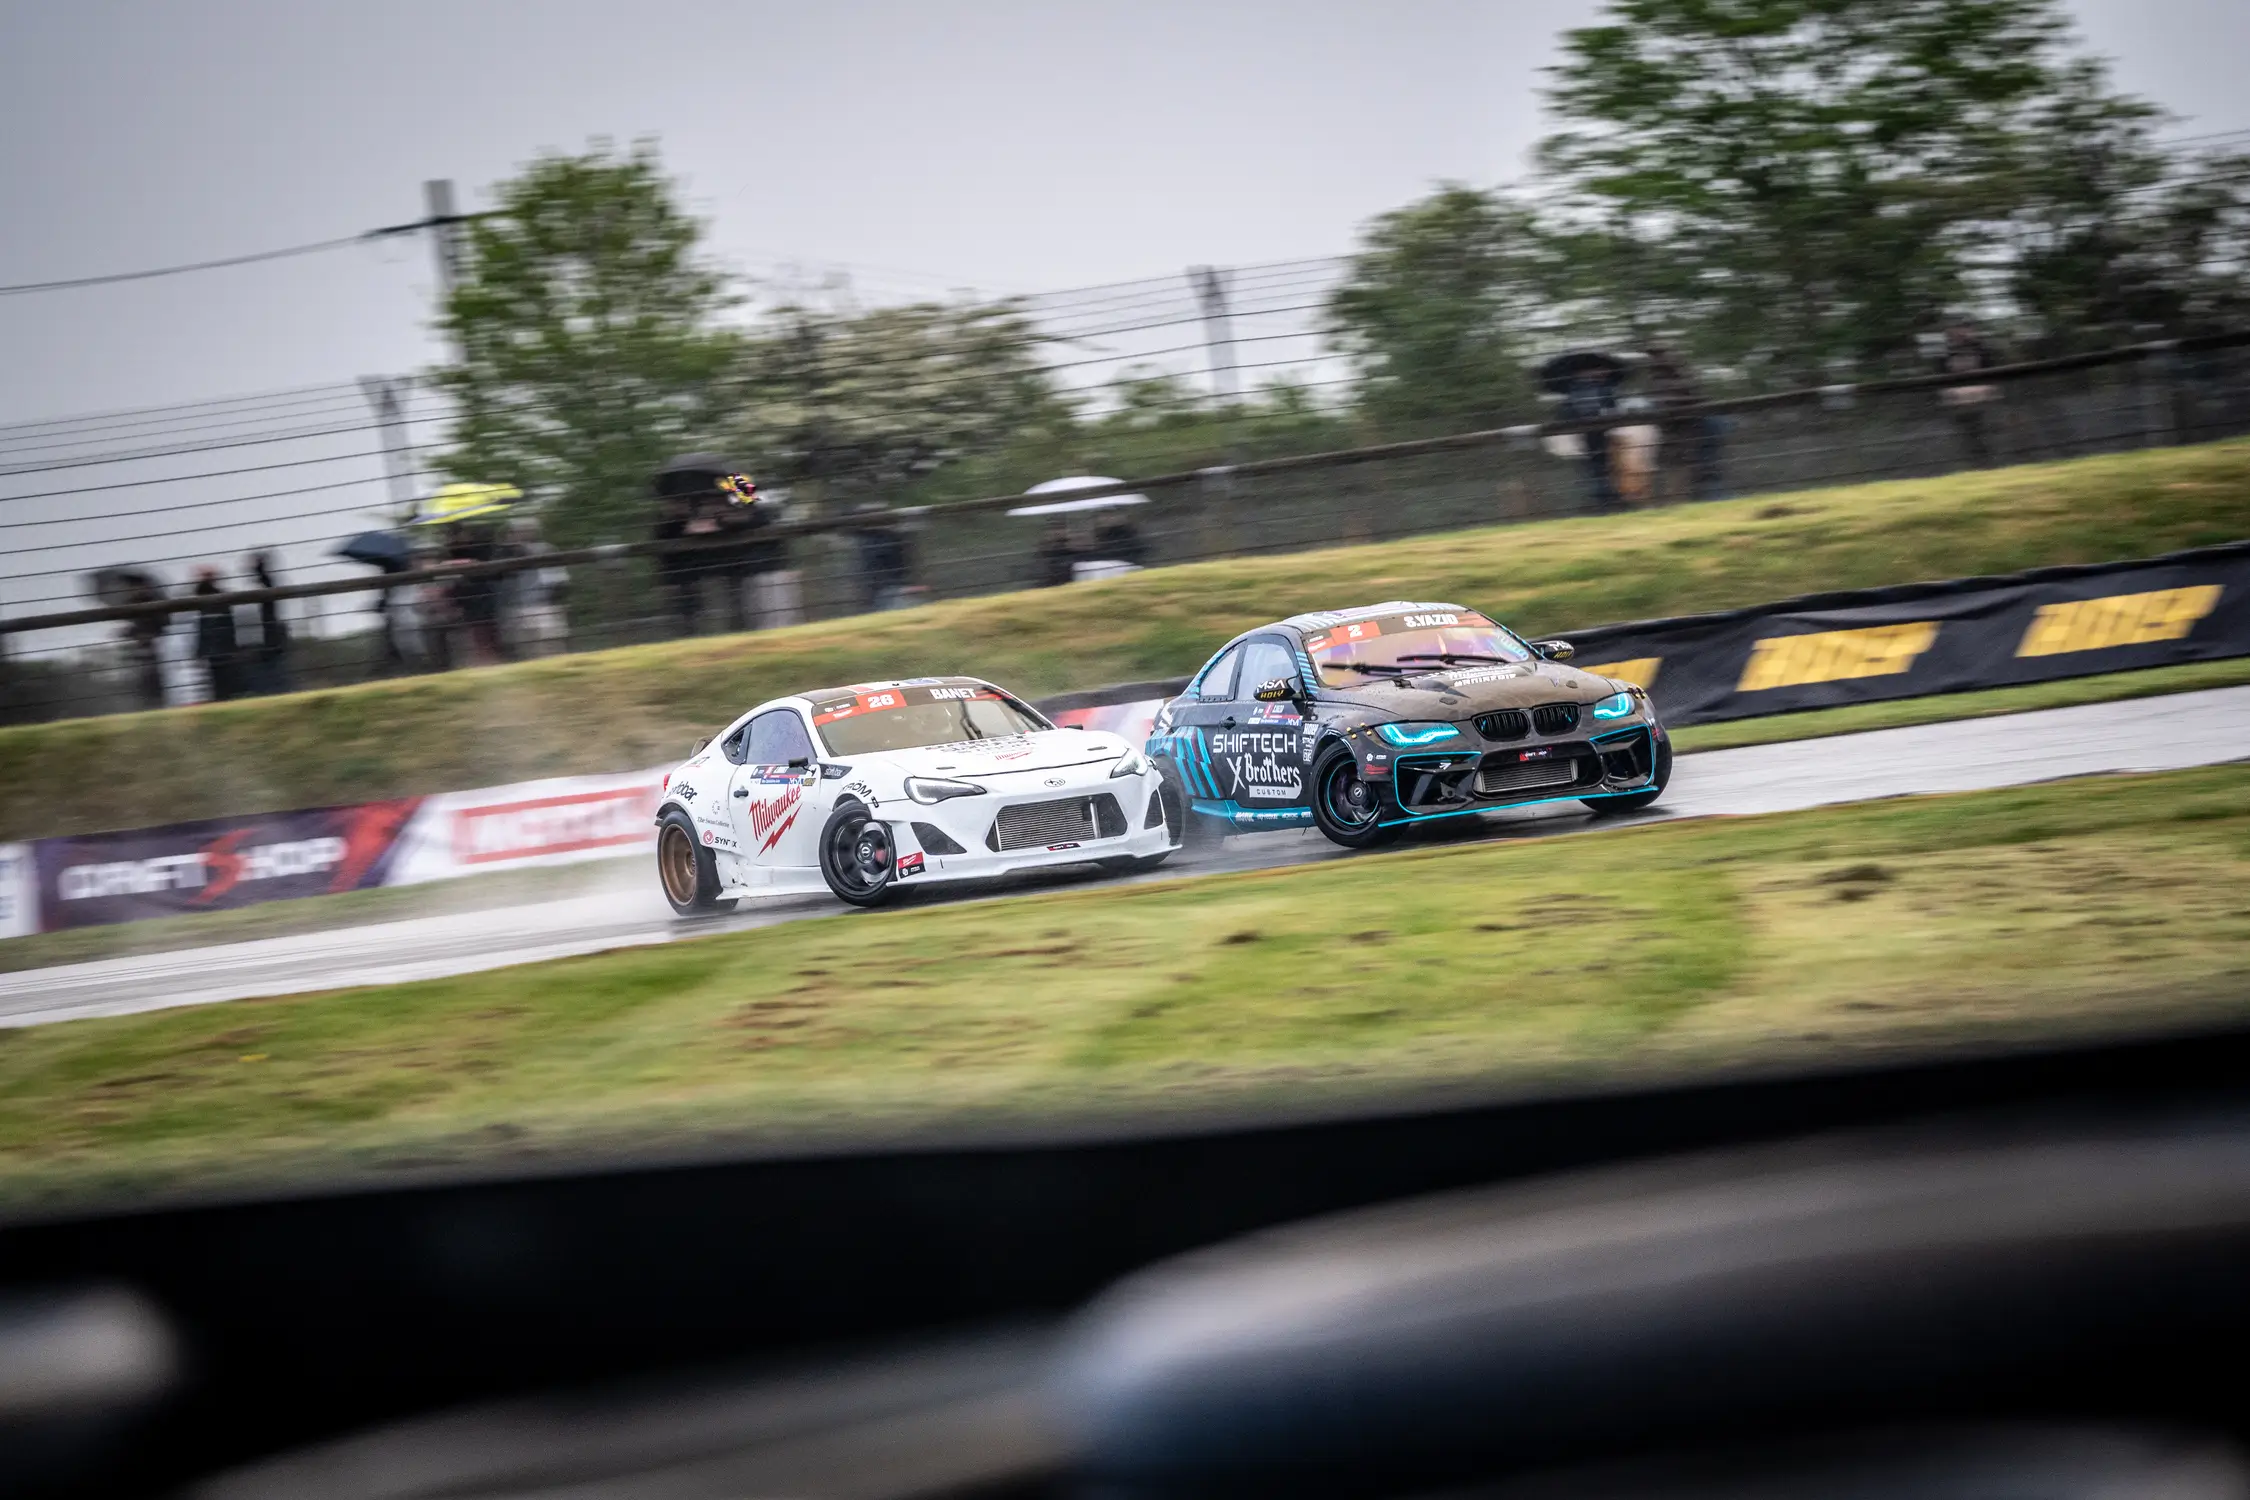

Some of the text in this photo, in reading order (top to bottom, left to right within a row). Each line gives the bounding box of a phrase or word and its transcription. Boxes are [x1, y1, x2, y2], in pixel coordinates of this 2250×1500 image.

[1347, 613, 1459, 638] 2 S.YAZID
[929, 687, 977, 700] BANET
[1257, 679, 1286, 693] MSA
[1212, 733, 1297, 754] SHIFTECH
[1226, 751, 1303, 796] X Brothers
[1256, 788, 1287, 796] CUSTOM
[748, 783, 802, 842] Milwaukee
